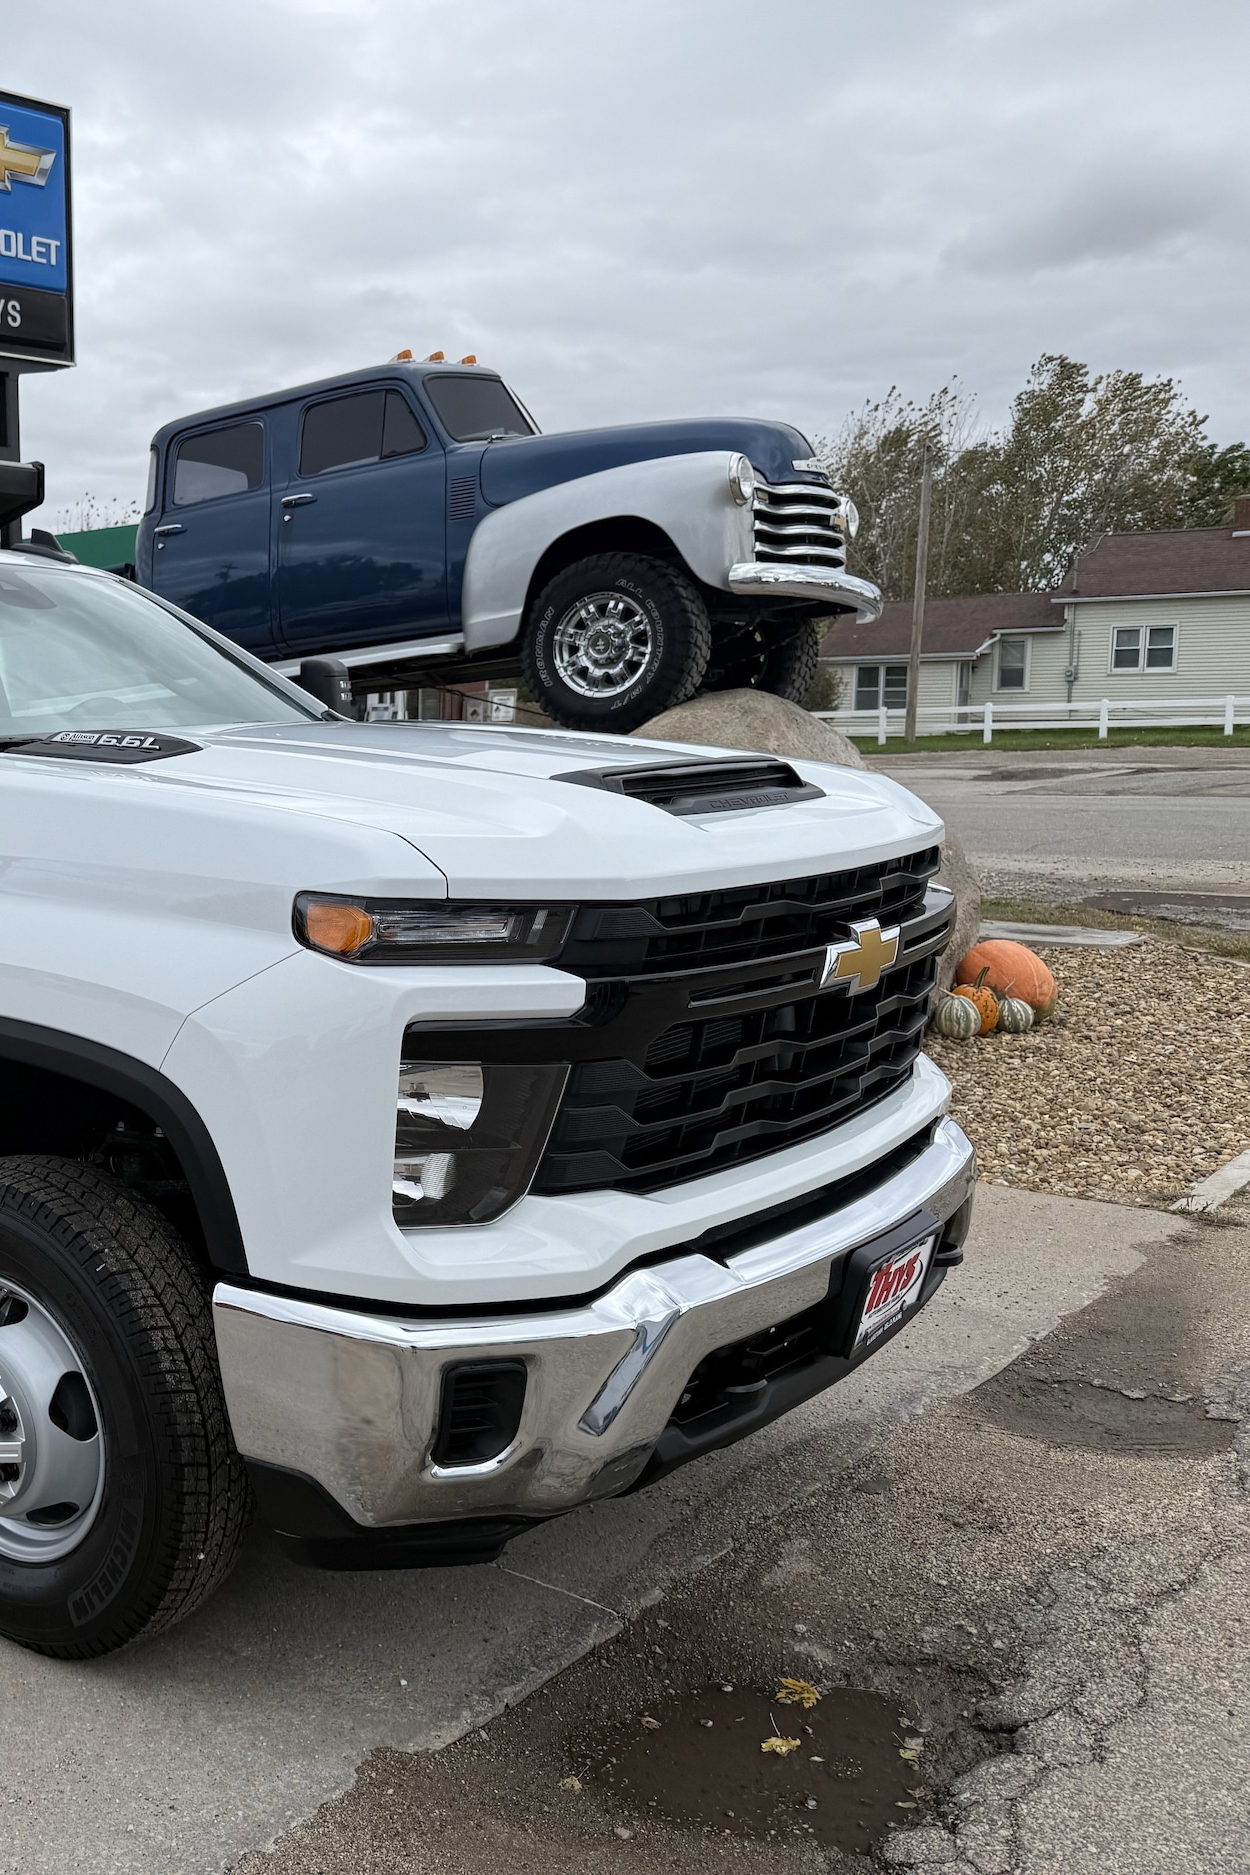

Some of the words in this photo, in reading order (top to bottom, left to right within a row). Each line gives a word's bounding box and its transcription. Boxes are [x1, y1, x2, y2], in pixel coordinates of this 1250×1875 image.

[615, 578, 644, 598] ALL
[535, 606, 555, 688] IRONMAN
[645, 599, 664, 684] COUNTRY
[610, 685, 643, 710] M/T
[98, 734, 160, 750] 6.6L
[709, 791, 789, 809] CHEVROLET
[865, 1251, 922, 1315] THYS
[71, 1505, 140, 1621] MICHELIN
